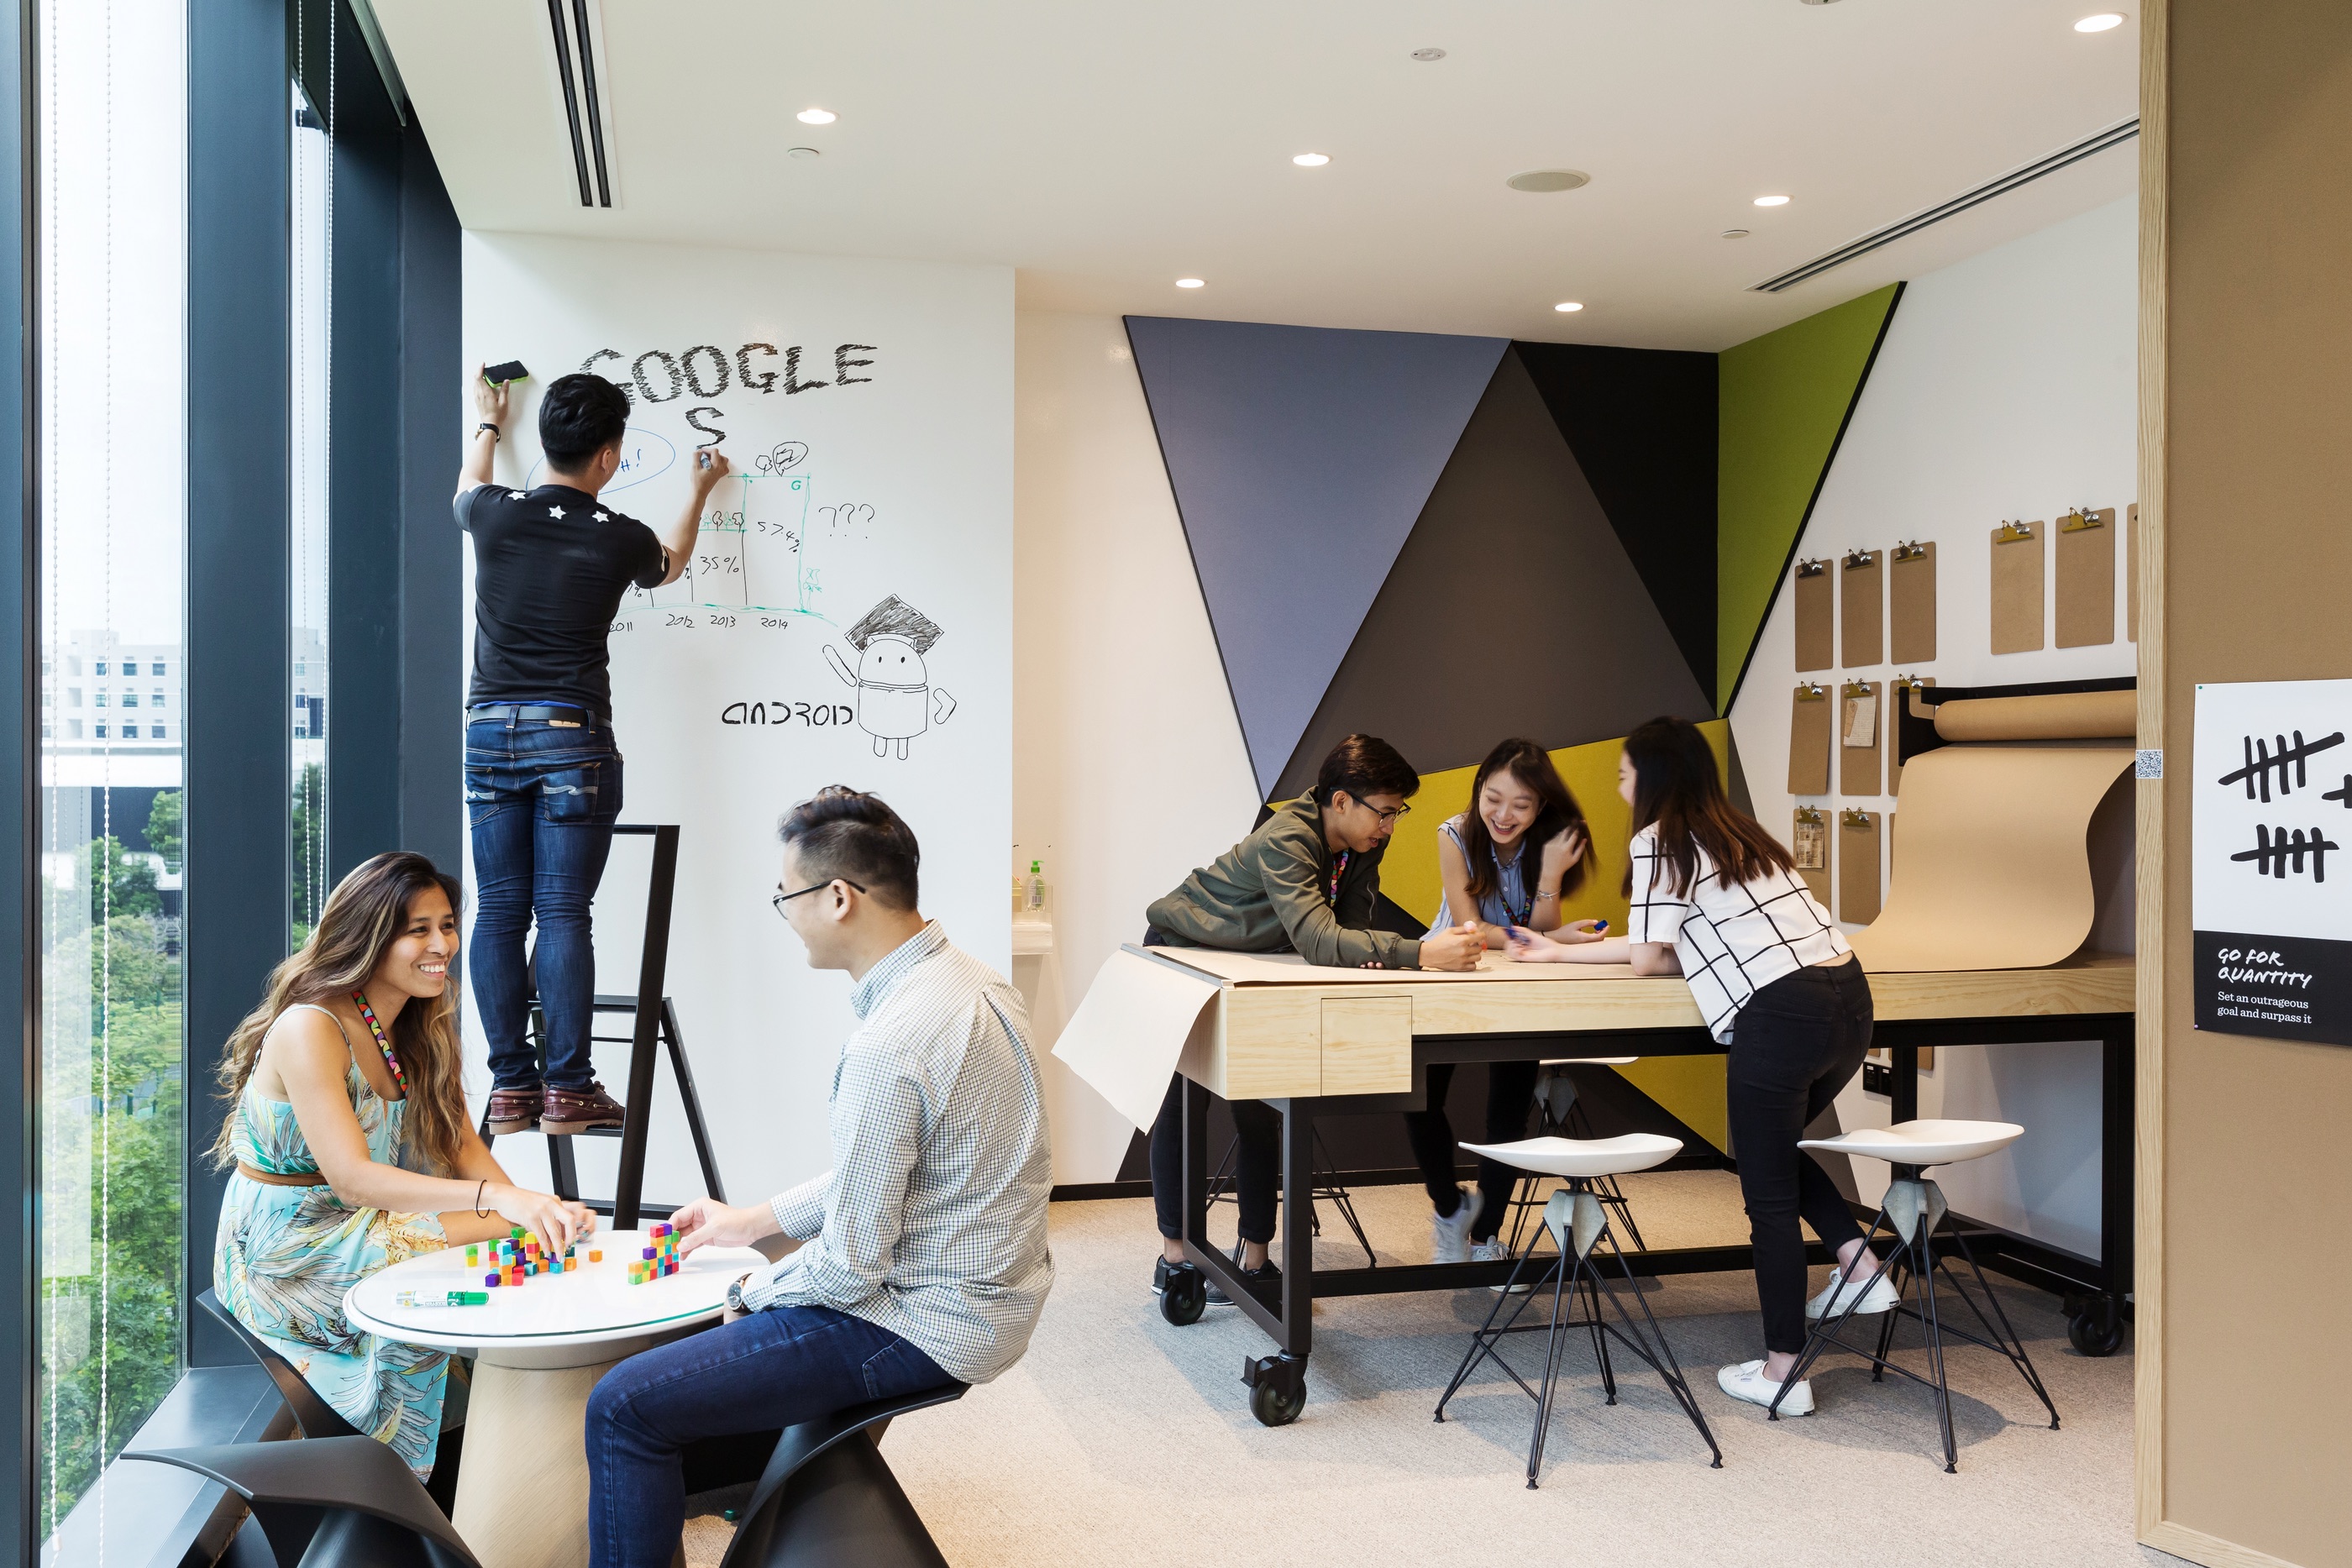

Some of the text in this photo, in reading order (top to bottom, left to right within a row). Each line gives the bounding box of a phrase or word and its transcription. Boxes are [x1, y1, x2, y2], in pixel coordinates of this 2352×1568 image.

[580, 343, 878, 406] GOOGLE
[685, 407, 727, 449] S
[790, 480, 801, 490] G
[700, 556, 740, 575] 35%
[665, 613, 696, 628] 2012
[710, 615, 736, 628] 2013
[761, 617, 789, 629] 2014
[2218, 948, 2285, 967] GO FOR
[2218, 967, 2313, 989] QUANTITY
[2218, 991, 2309, 1009] Set an outrageous
[2218, 1006, 2313, 1024] goal and surpass it
